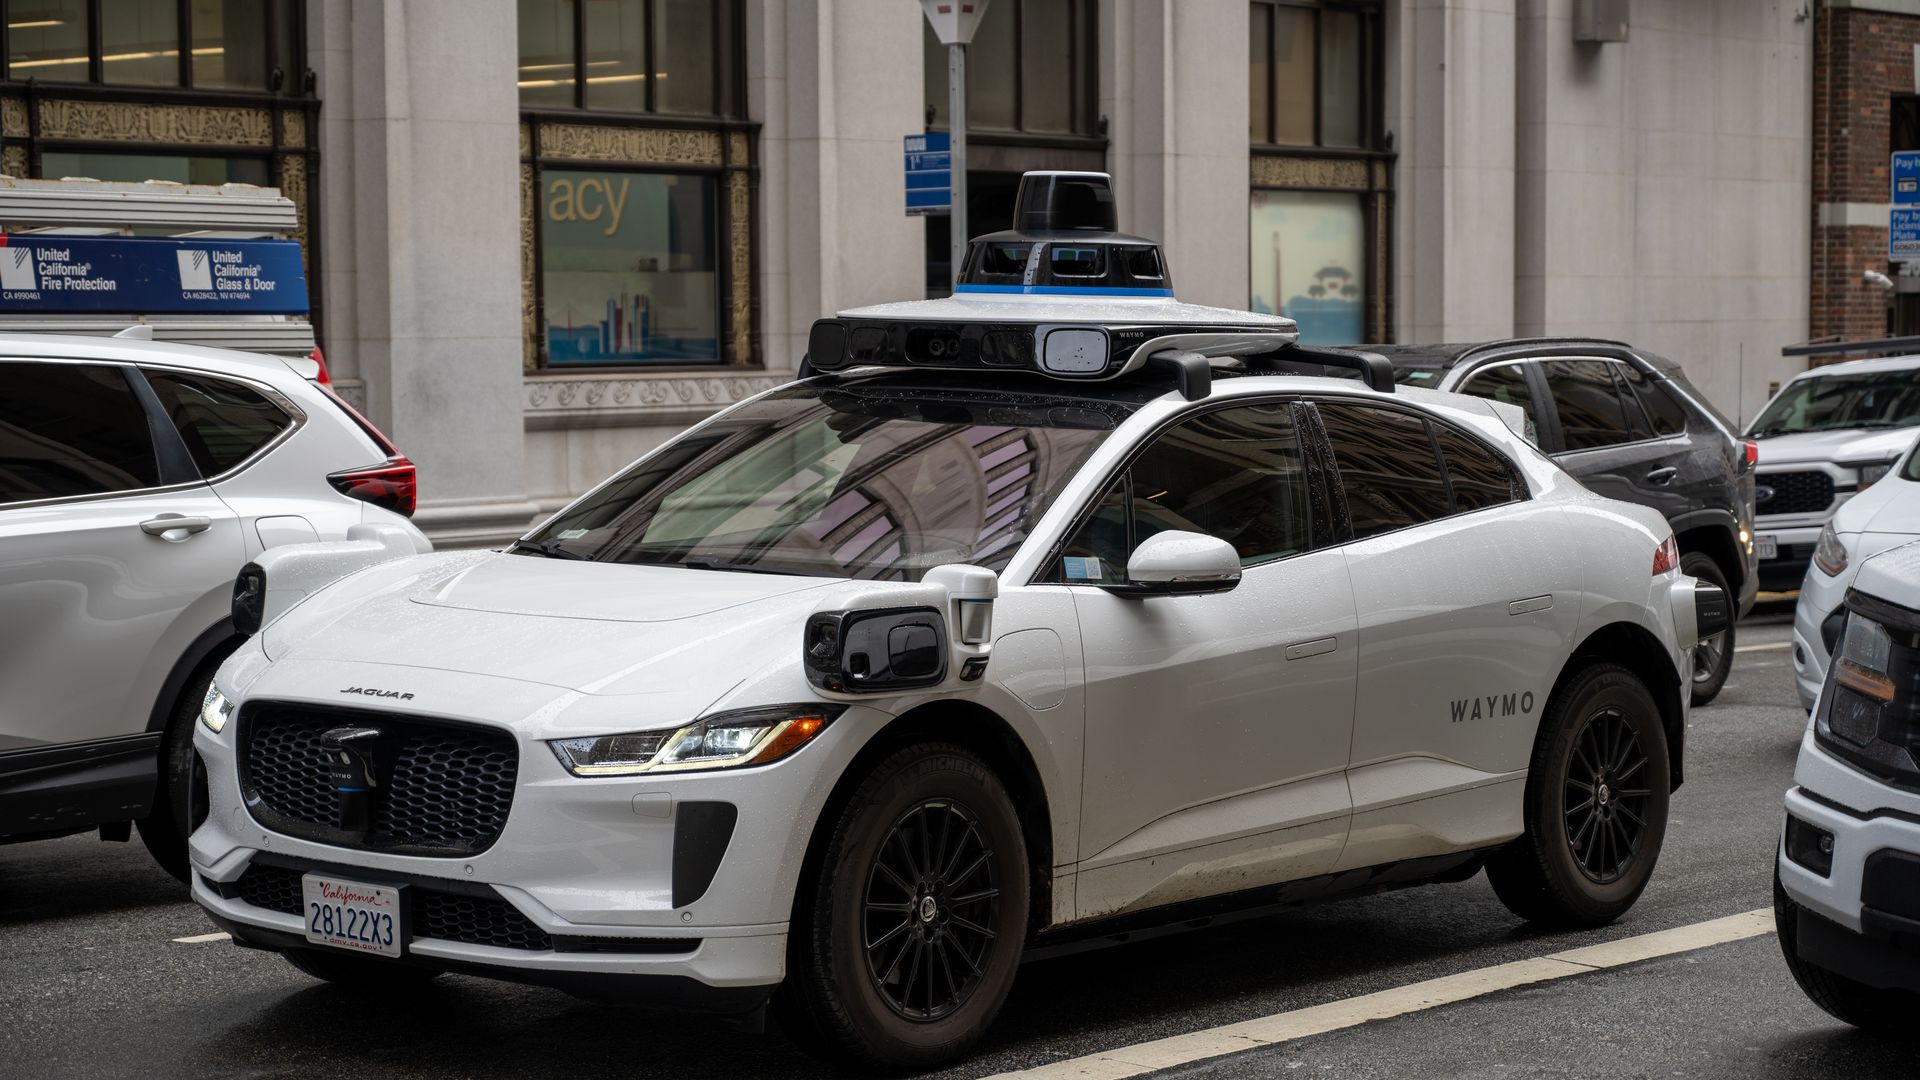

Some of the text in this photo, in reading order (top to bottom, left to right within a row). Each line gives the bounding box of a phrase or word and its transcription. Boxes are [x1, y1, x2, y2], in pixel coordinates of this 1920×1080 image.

[1895, 158, 1914, 170] Pay
[548, 177, 630, 236] acy
[1893, 210, 1920, 222] Pay b
[1893, 230, 1917, 240] Plate
[37, 247, 70, 261] United
[212, 250, 242, 263] United
[42, 277, 117, 290] Fire Protection
[216, 278, 276, 290] Glass & Door
[2, 292, 41, 300] CA #990461
[182, 292, 192, 300] CA
[229, 292, 251, 300] #74694
[340, 686, 415, 701] JAGUAR
[1450, 690, 1534, 723] WAYMO
[322, 882, 381, 906] California
[310, 902, 393, 946] 28122X3
[329, 938, 379, 952] dmv.ca.gov
